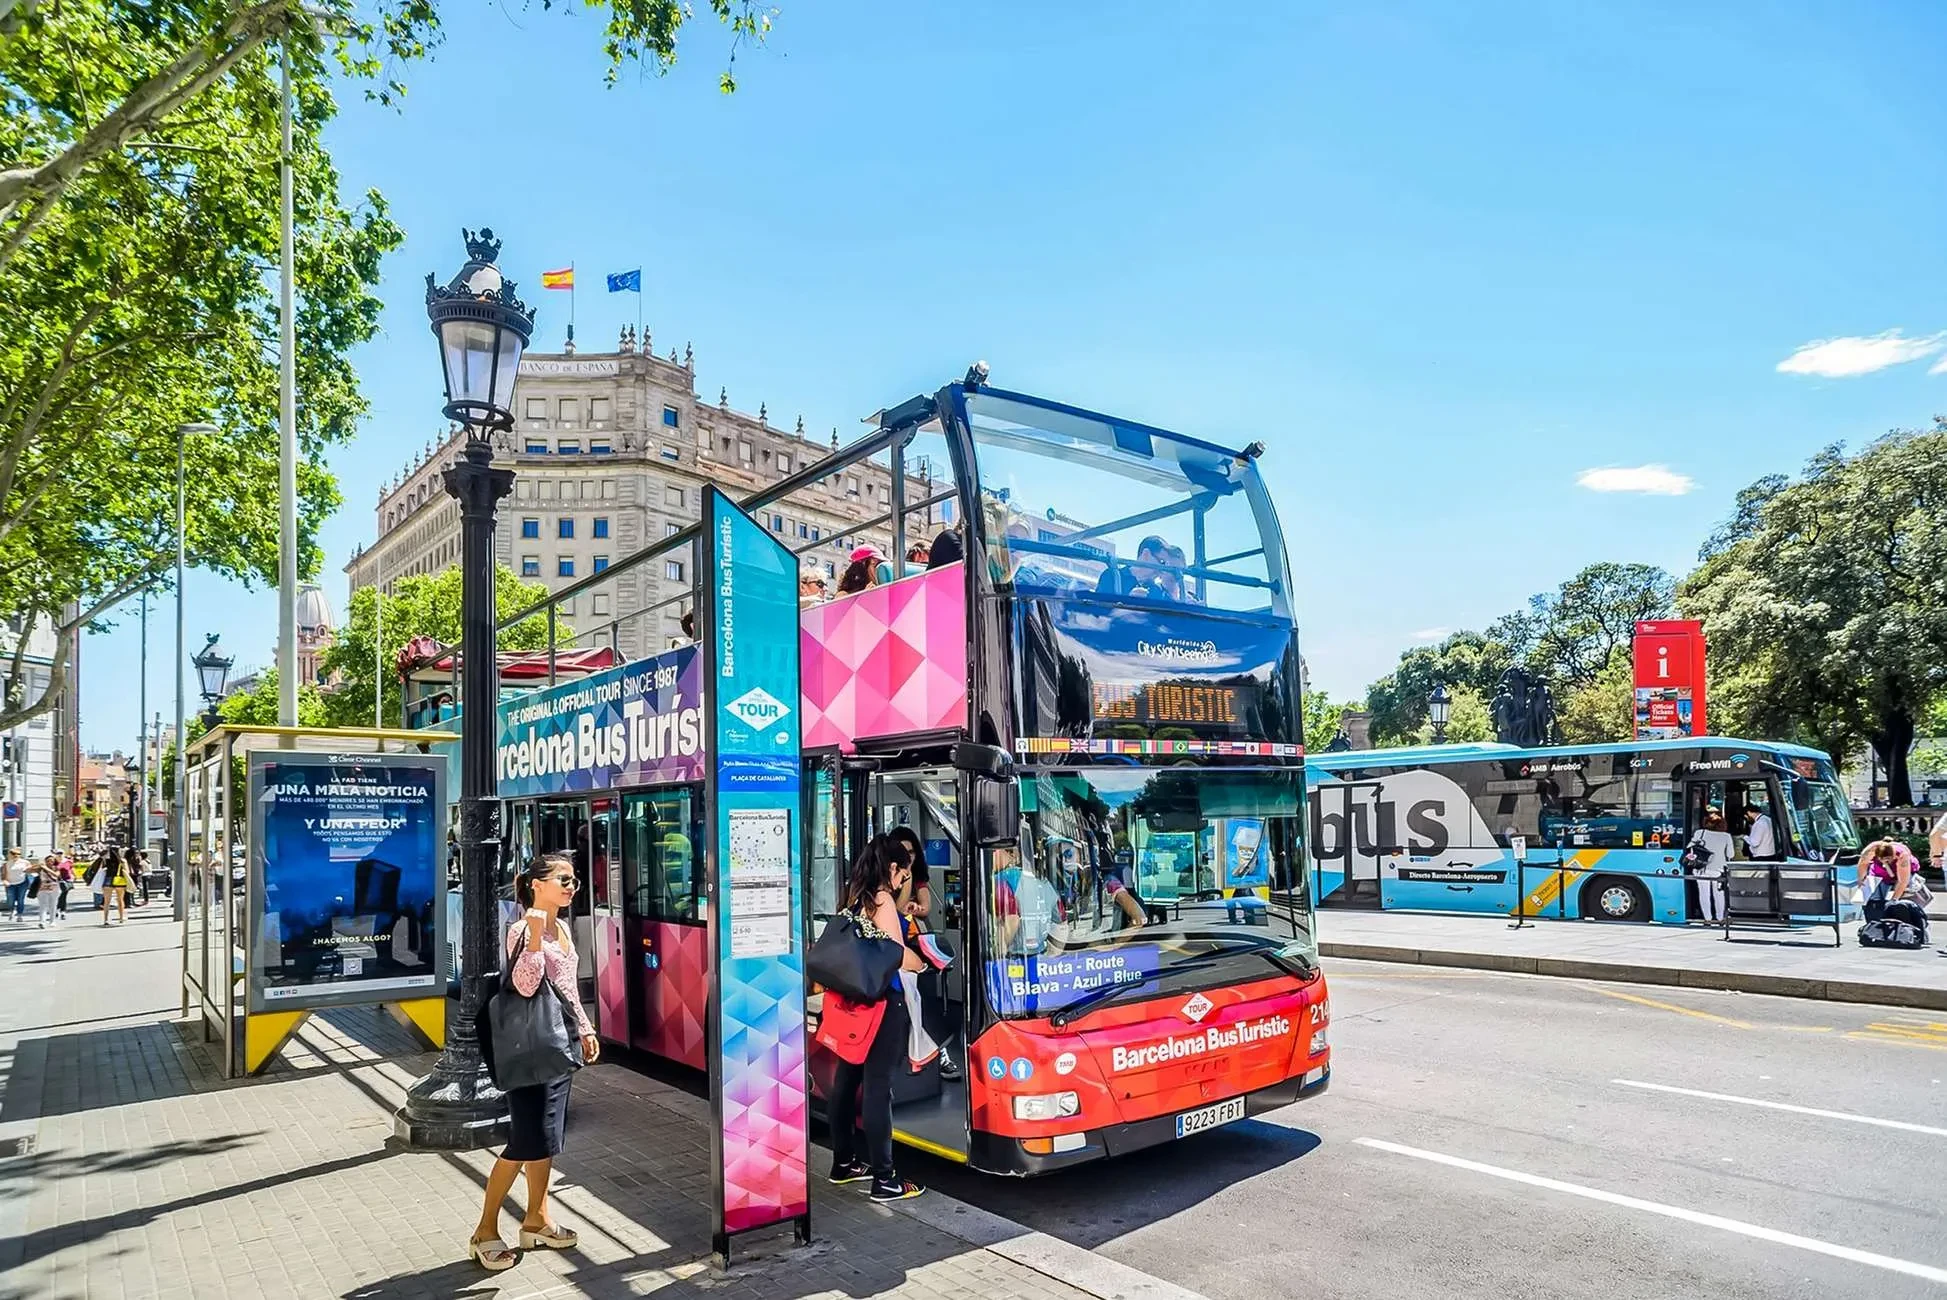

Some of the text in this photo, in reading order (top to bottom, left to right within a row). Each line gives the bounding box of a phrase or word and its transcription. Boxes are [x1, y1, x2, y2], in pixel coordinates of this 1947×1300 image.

[520, 360, 560, 372] BANCO
[721, 599, 735, 677] Barcelona
[1167, 638, 1200, 647] Worldwide
[1657, 647, 1670, 678] i
[507, 712, 520, 726] THE
[520, 703, 553, 724] ORIGINAL
[558, 691, 595, 714] OFFICIAL
[595, 681, 621, 702] TOUR
[623, 671, 653, 697] SINCE
[653, 665, 678, 690] 1987
[1146, 684, 1238, 722] TURISTIC
[737, 703, 778, 717] TOUR
[497, 727, 575, 780] rcelona
[1530, 764, 1548, 772] AMB
[1690, 761, 1711, 770] Free
[275, 784, 428, 797] UNA MALA NOTICIA
[304, 818, 315, 829] Y
[320, 818, 354, 829] UNA
[1409, 871, 1430, 880] Directo
[1037, 962, 1073, 977] Ruta
[1085, 956, 1124, 971] Route
[1012, 981, 1060, 996] Blava
[1072, 973, 1102, 989] Azul
[1114, 970, 1142, 984] Blue
[1188, 1003, 1208, 1014] TOUR
[1112, 1036, 1206, 1072] Barcelona
[1185, 1101, 1242, 1132] 9223 FBT
